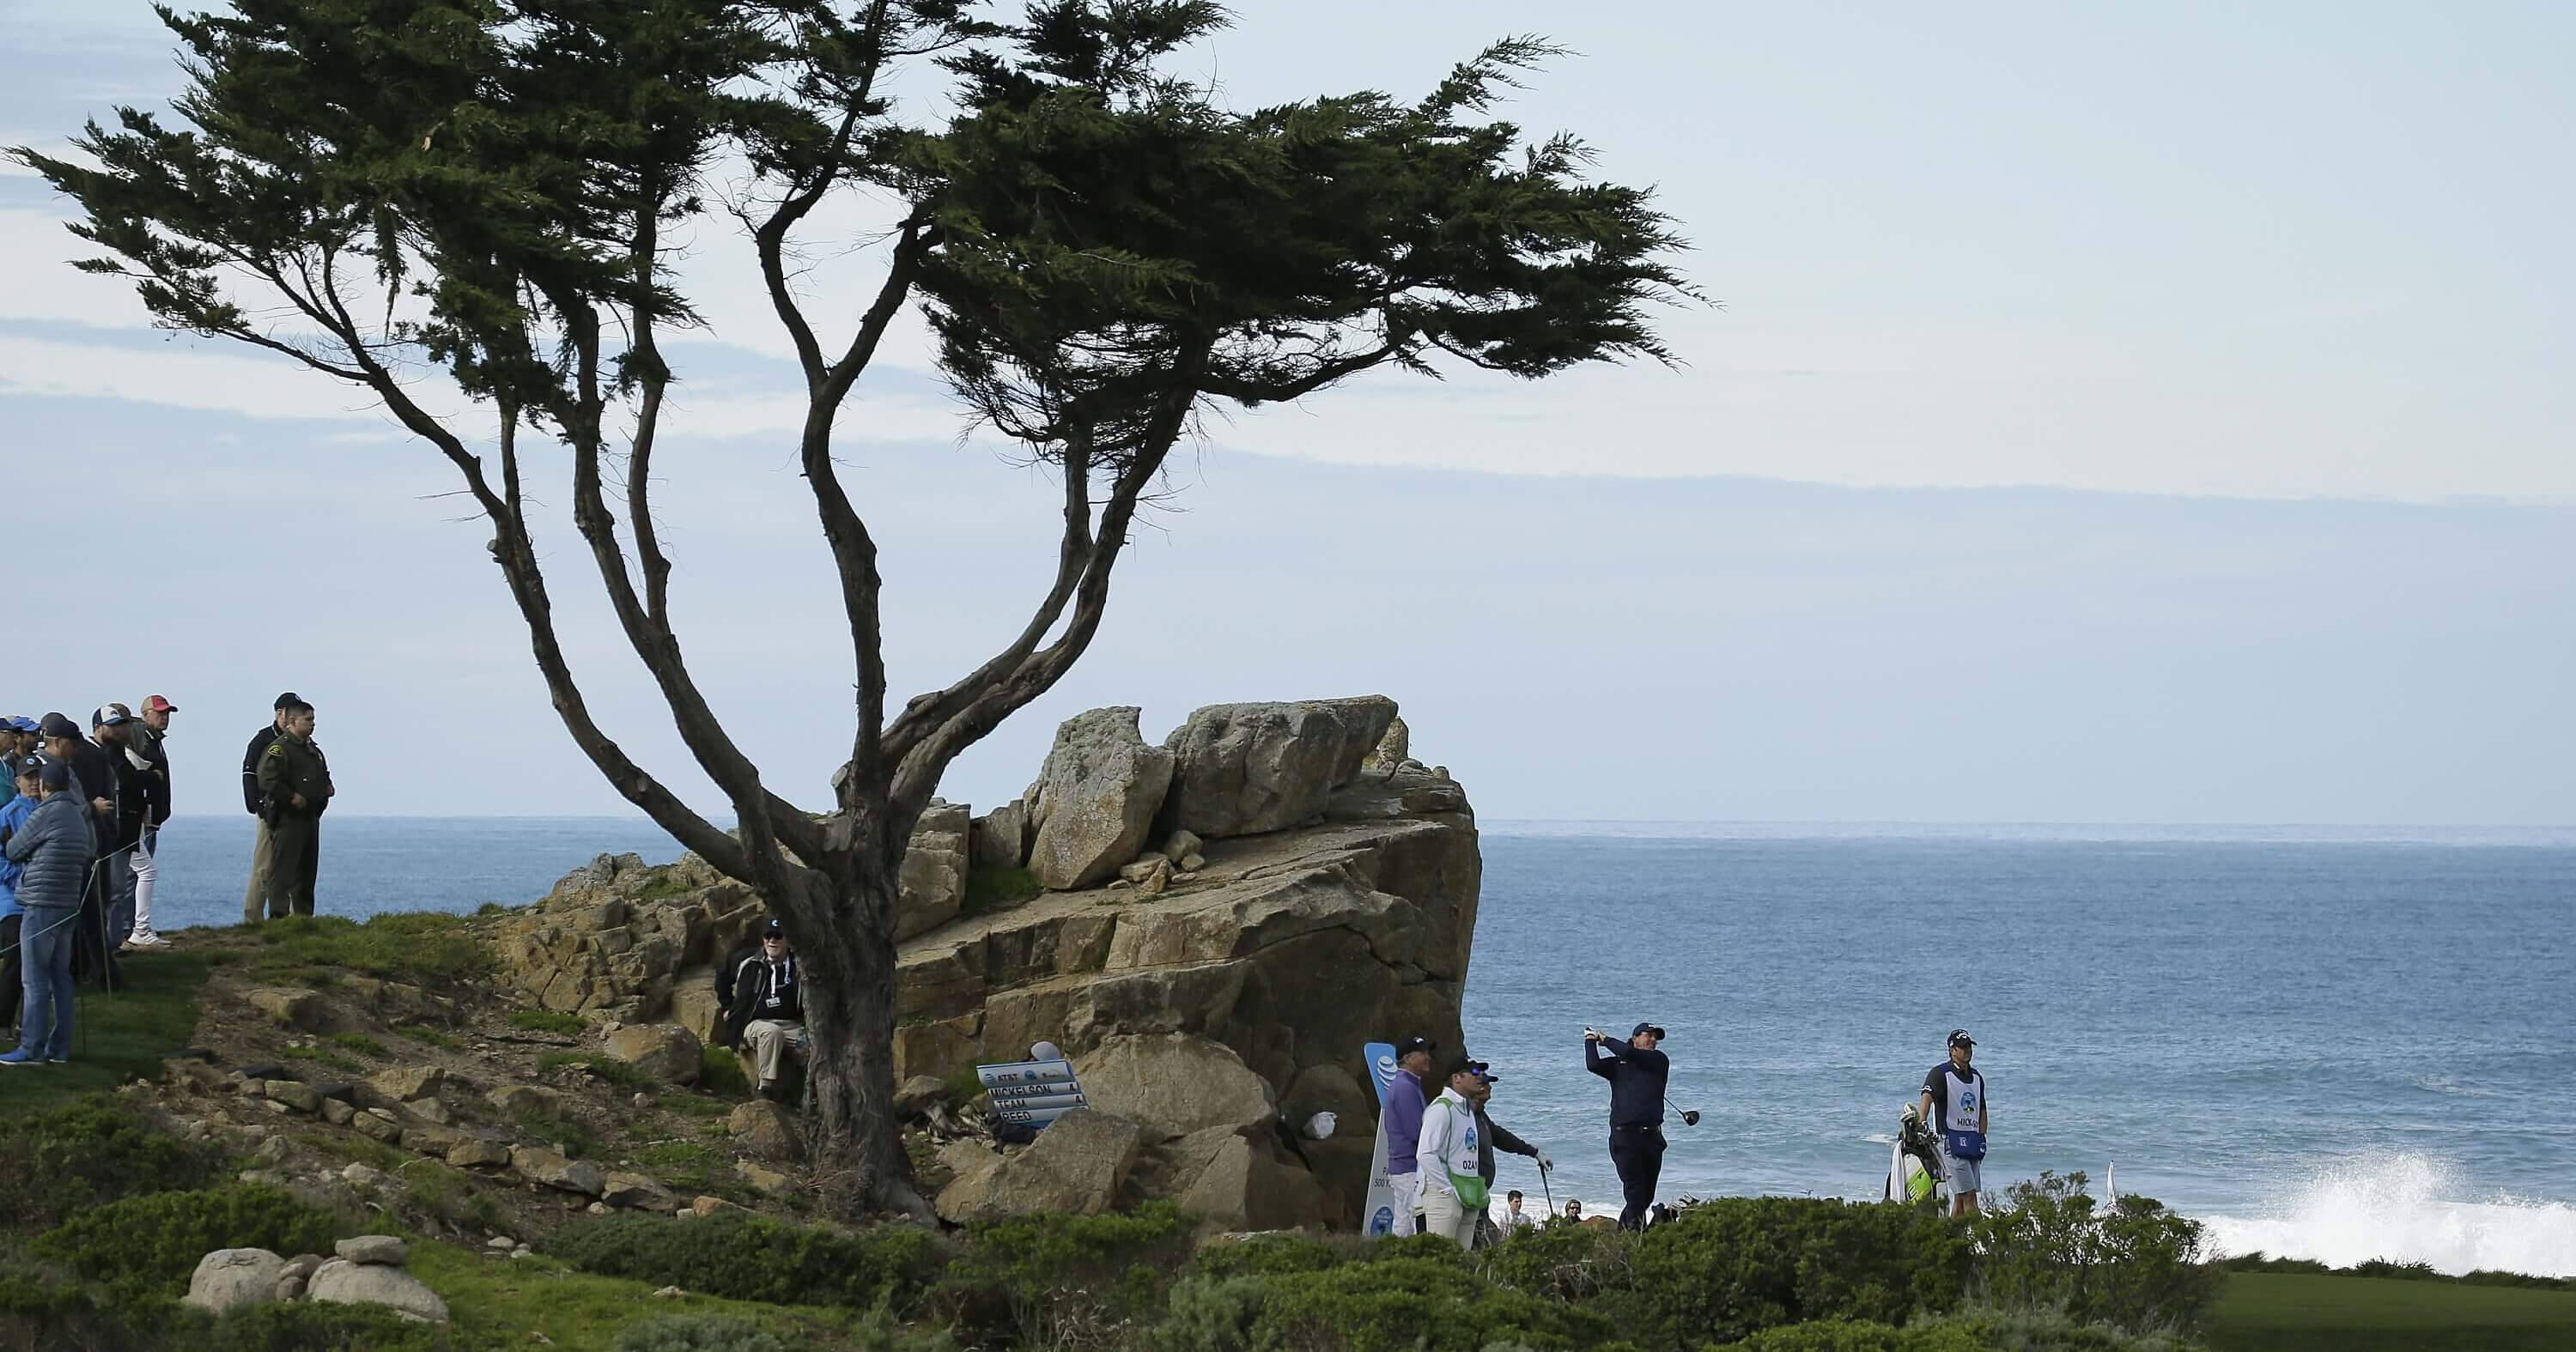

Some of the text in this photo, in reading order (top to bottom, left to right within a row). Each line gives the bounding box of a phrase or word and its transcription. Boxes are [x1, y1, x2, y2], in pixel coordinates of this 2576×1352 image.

[998, 1073, 1018, 1082] AT&T
[989, 1084, 1052, 1096] MICKELSON
[997, 1099, 1027, 1109] TEAM
[1002, 1111, 1031, 1121] REED
